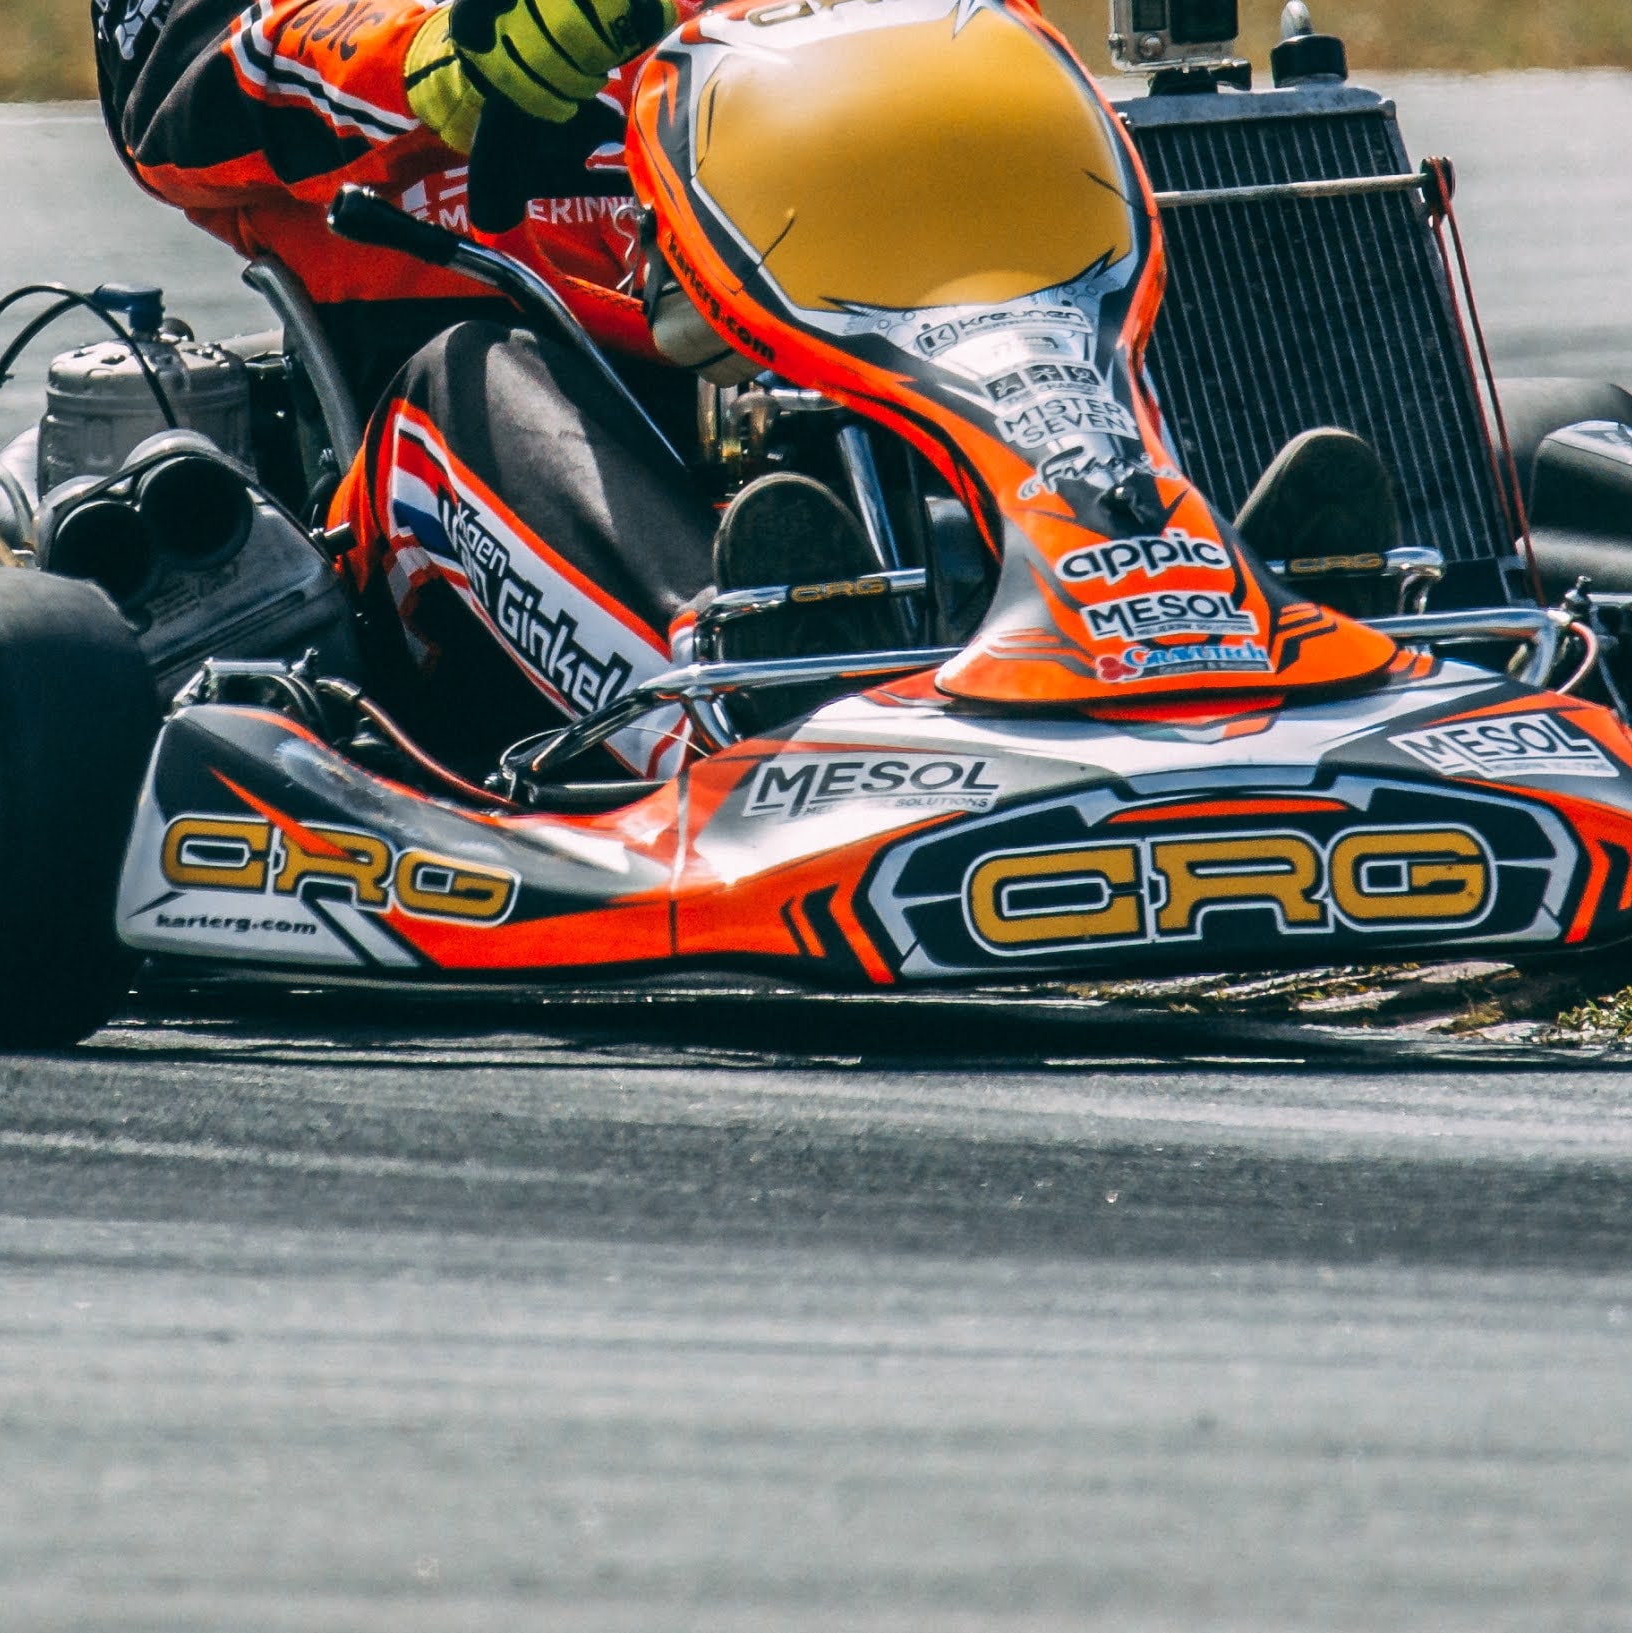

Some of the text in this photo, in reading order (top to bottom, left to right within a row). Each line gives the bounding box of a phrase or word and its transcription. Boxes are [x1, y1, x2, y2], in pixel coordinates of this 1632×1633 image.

[1002, 397, 1122, 434] MISTER
[1022, 413, 1130, 443] SEVEN
[1062, 532, 1225, 578] appic
[791, 576, 886, 603] CRG
[1087, 593, 1249, 637] MESOL
[498, 578, 622, 712] Ginkel
[1401, 718, 1593, 772] MESOL
[757, 761, 999, 817] MESOL
[160, 814, 521, 926] CRG
[966, 825, 1494, 956] CRG
[156, 913, 318, 936] kartcrg.com
